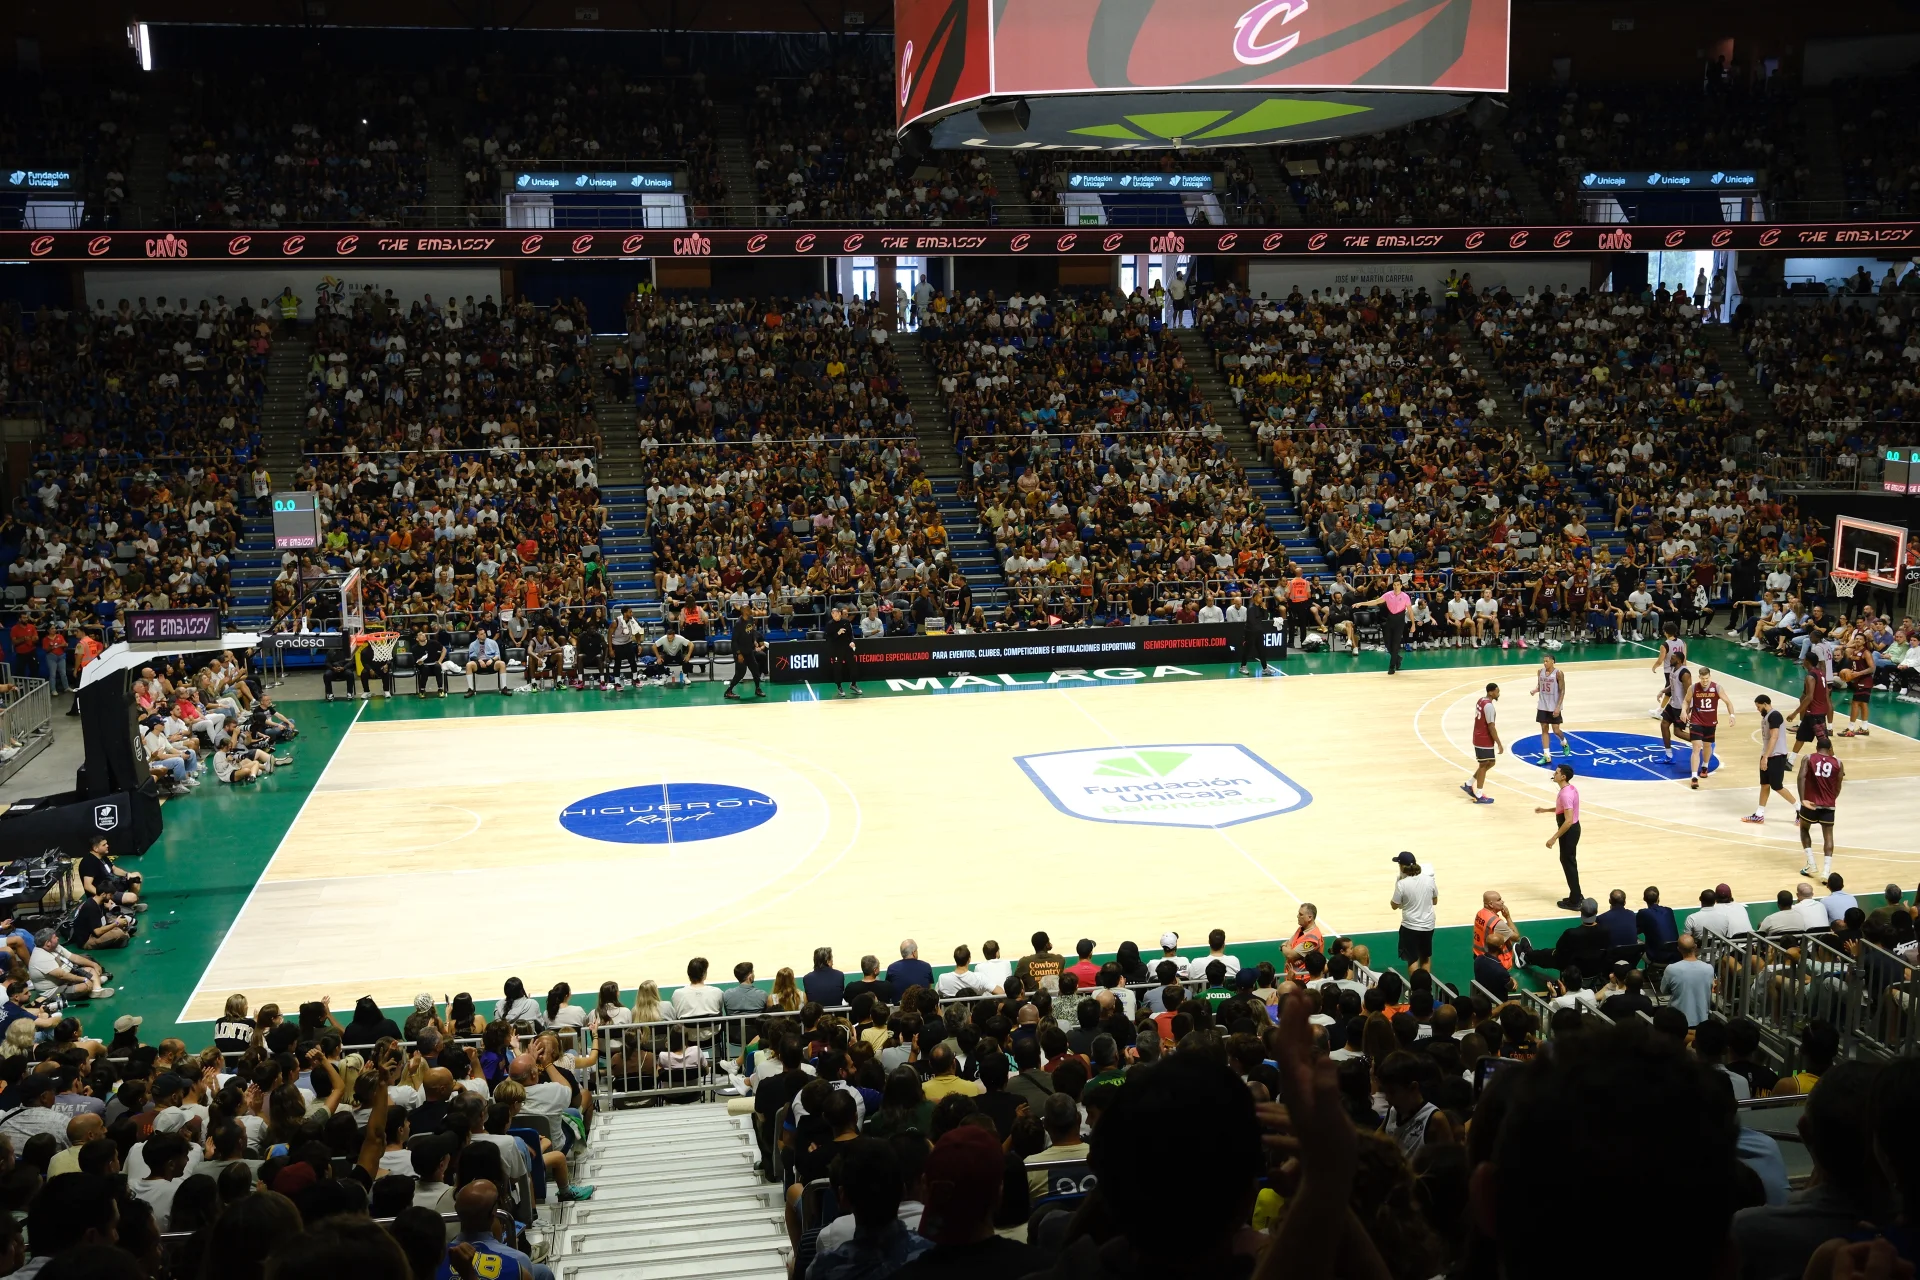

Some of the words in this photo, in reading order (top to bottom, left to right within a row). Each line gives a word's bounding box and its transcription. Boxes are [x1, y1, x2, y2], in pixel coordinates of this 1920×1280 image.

[28, 171, 69, 181] Fundación
[1083, 174, 1112, 182] Fundación
[1132, 174, 1161, 182] Fundación
[1182, 174, 1211, 182] Fundación
[1597, 176, 1626, 186] Unicaja
[1661, 176, 1691, 186] Unicaja
[1725, 175, 1754, 185] Unicaja
[29, 179, 59, 188] Unicaja
[531, 178, 560, 188] Unicaja
[589, 178, 617, 188] Unicaja
[645, 179, 672, 188] Unicaja
[1083, 180, 1104, 188] Unicaja
[1132, 180, 1153, 188] Unicaja
[1182, 180, 1203, 188] Unicaja
[145, 234, 188, 257] CAVS
[378, 239, 408, 250] THE
[418, 239, 495, 250] EMBASSY
[673, 233, 711, 255] CAVS
[881, 237, 908, 248] THE
[916, 237, 986, 248] EMBASSY
[1150, 231, 1185, 252] CAVS
[1343, 236, 1369, 247] THE
[1376, 235, 1443, 247] EMBASSY
[1599, 229, 1632, 249] CAVS
[1799, 231, 1828, 242] THE
[1836, 230, 1913, 242] EMBASSY
[1361, 274, 1384, 283] MARTÍN
[1386, 274, 1414, 283] CARPENA
[1886, 450, 1900, 461] 0.0
[274, 499, 296, 511] 0.0
[278, 539, 287, 547] THE
[290, 537, 314, 547] EMBASSY
[134, 619, 155, 637] THE
[160, 617, 211, 635] EMBASSY
[275, 637, 325, 649] endesa
[1143, 637, 1227, 650] ISEMSPORTSEVENTS.COM
[859, 653, 884, 663] TÉCNICO
[886, 651, 929, 662] ESPECIALIZADO
[932, 650, 948, 660] PARA
[949, 649, 977, 659] EVENTOS,
[978, 648, 1002, 658] CLUBES,
[1003, 646, 1050, 656] COMPETICIONES
[1051, 645, 1055, 654] E
[1056, 643, 1100, 654] INSTALACIONES
[1102, 641, 1136, 651] DEPORTIVAS
[790, 653, 819, 670] ISEM
[1700, 698, 1712, 708] 12
[1814, 760, 1833, 778] 19
[1083, 777, 1252, 794] Fundación
[1118, 788, 1243, 804] Unicaja
[1101, 796, 1277, 814] Baloncesto
[626, 811, 715, 826] Resort
[1029, 961, 1060, 971] Cowboy
[1029, 968, 1061, 977] Country
